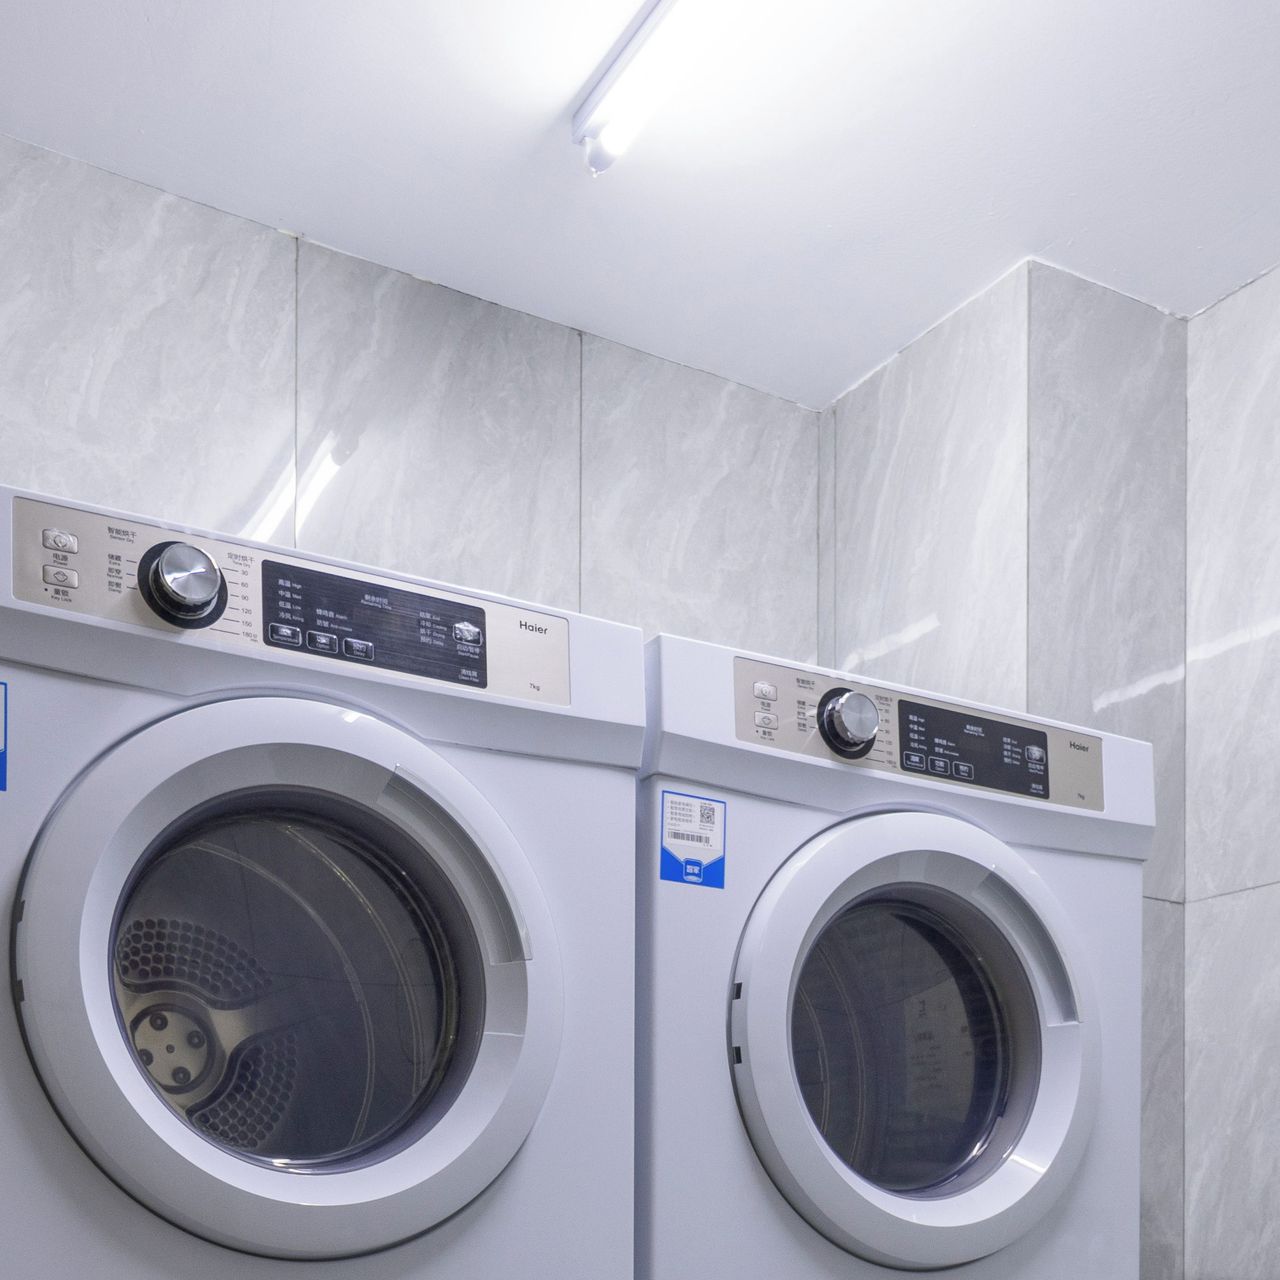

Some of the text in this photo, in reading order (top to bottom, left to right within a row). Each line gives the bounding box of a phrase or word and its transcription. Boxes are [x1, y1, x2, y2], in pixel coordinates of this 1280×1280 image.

[52, 553, 69, 562] 电源
[519, 620, 548, 635] Haier
[529, 682, 540, 691] 7kg
[1069, 741, 1089, 752] Haier
